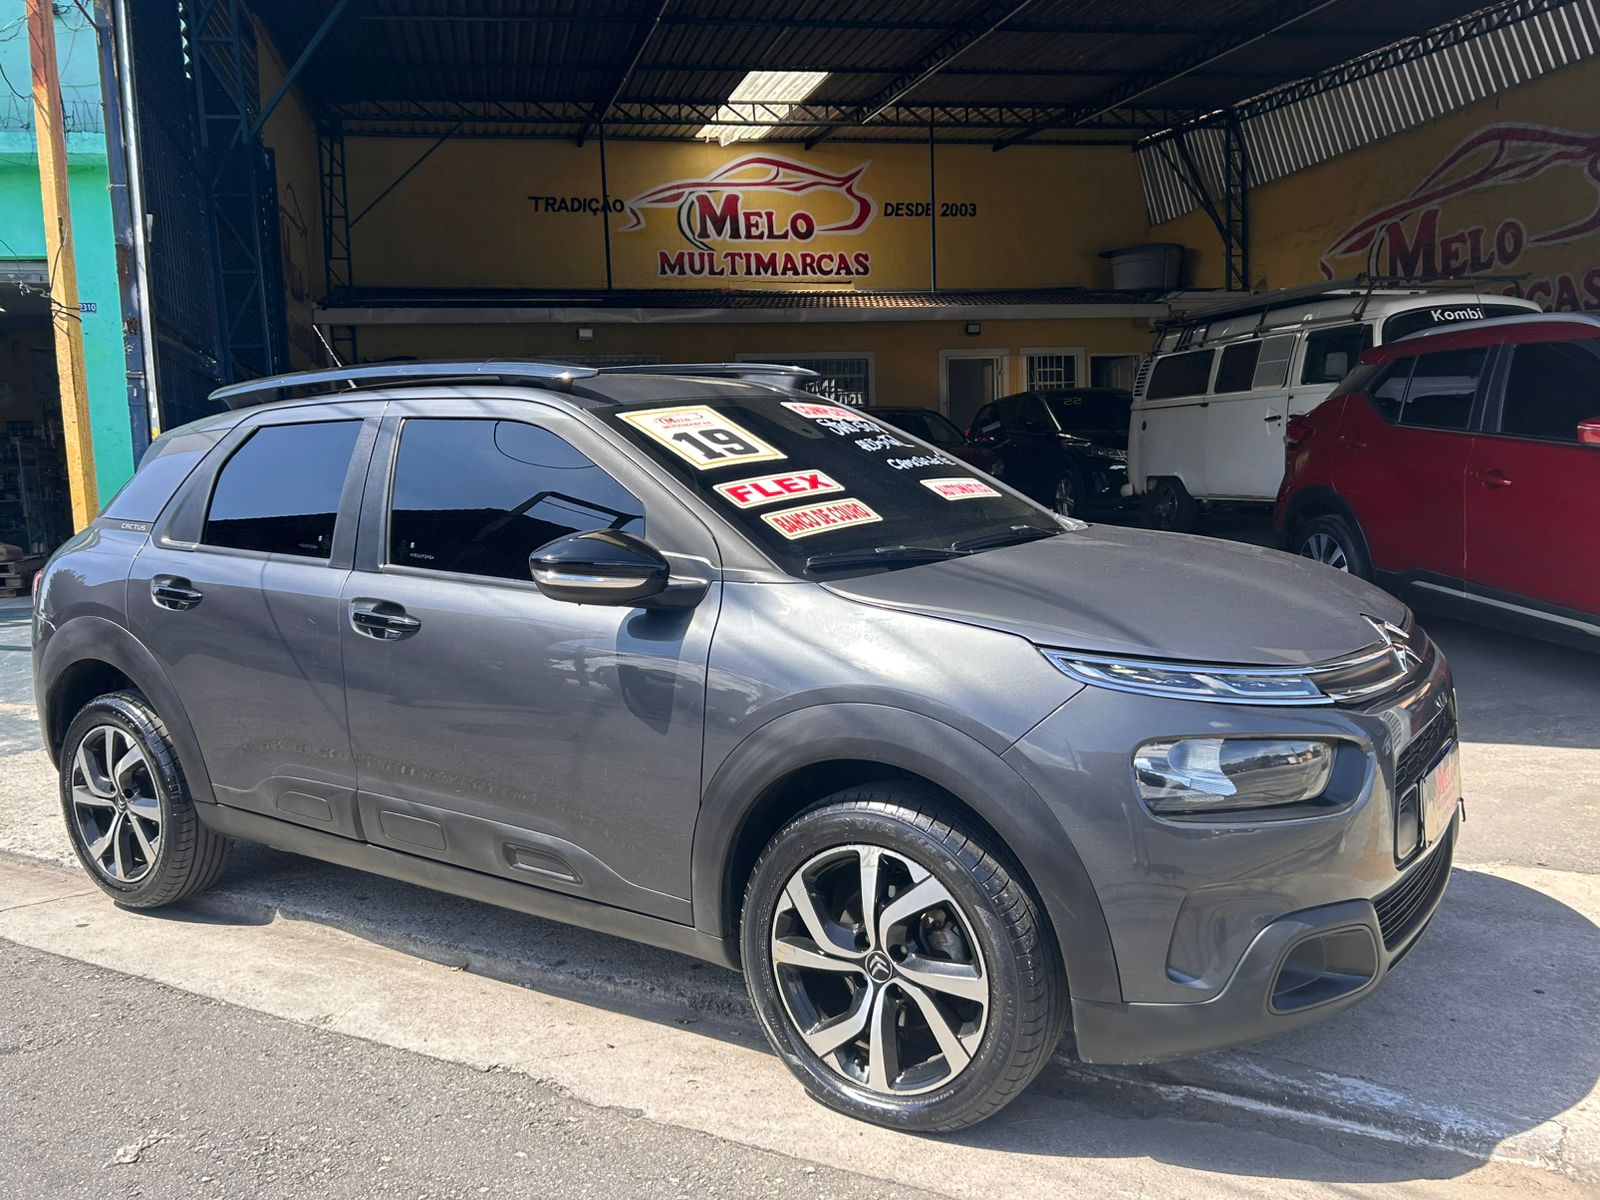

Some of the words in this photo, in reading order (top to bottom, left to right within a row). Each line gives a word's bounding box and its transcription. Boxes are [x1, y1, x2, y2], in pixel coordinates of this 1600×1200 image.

[528, 195, 625, 216] TRADIÇÃO
[695, 193, 816, 240] MELO
[883, 202, 932, 217] DESDE
[940, 202, 977, 217] 2003
[1383, 206, 1524, 283] MELO
[659, 251, 870, 276] MULTIMARCAS
[1431, 307, 1484, 322] Kombi
[672, 429, 760, 460] 19
[725, 474, 831, 503] FLEX
[772, 512, 821, 533] BANCO
[809, 508, 838, 525] DE
[826, 503, 872, 521] COURO
